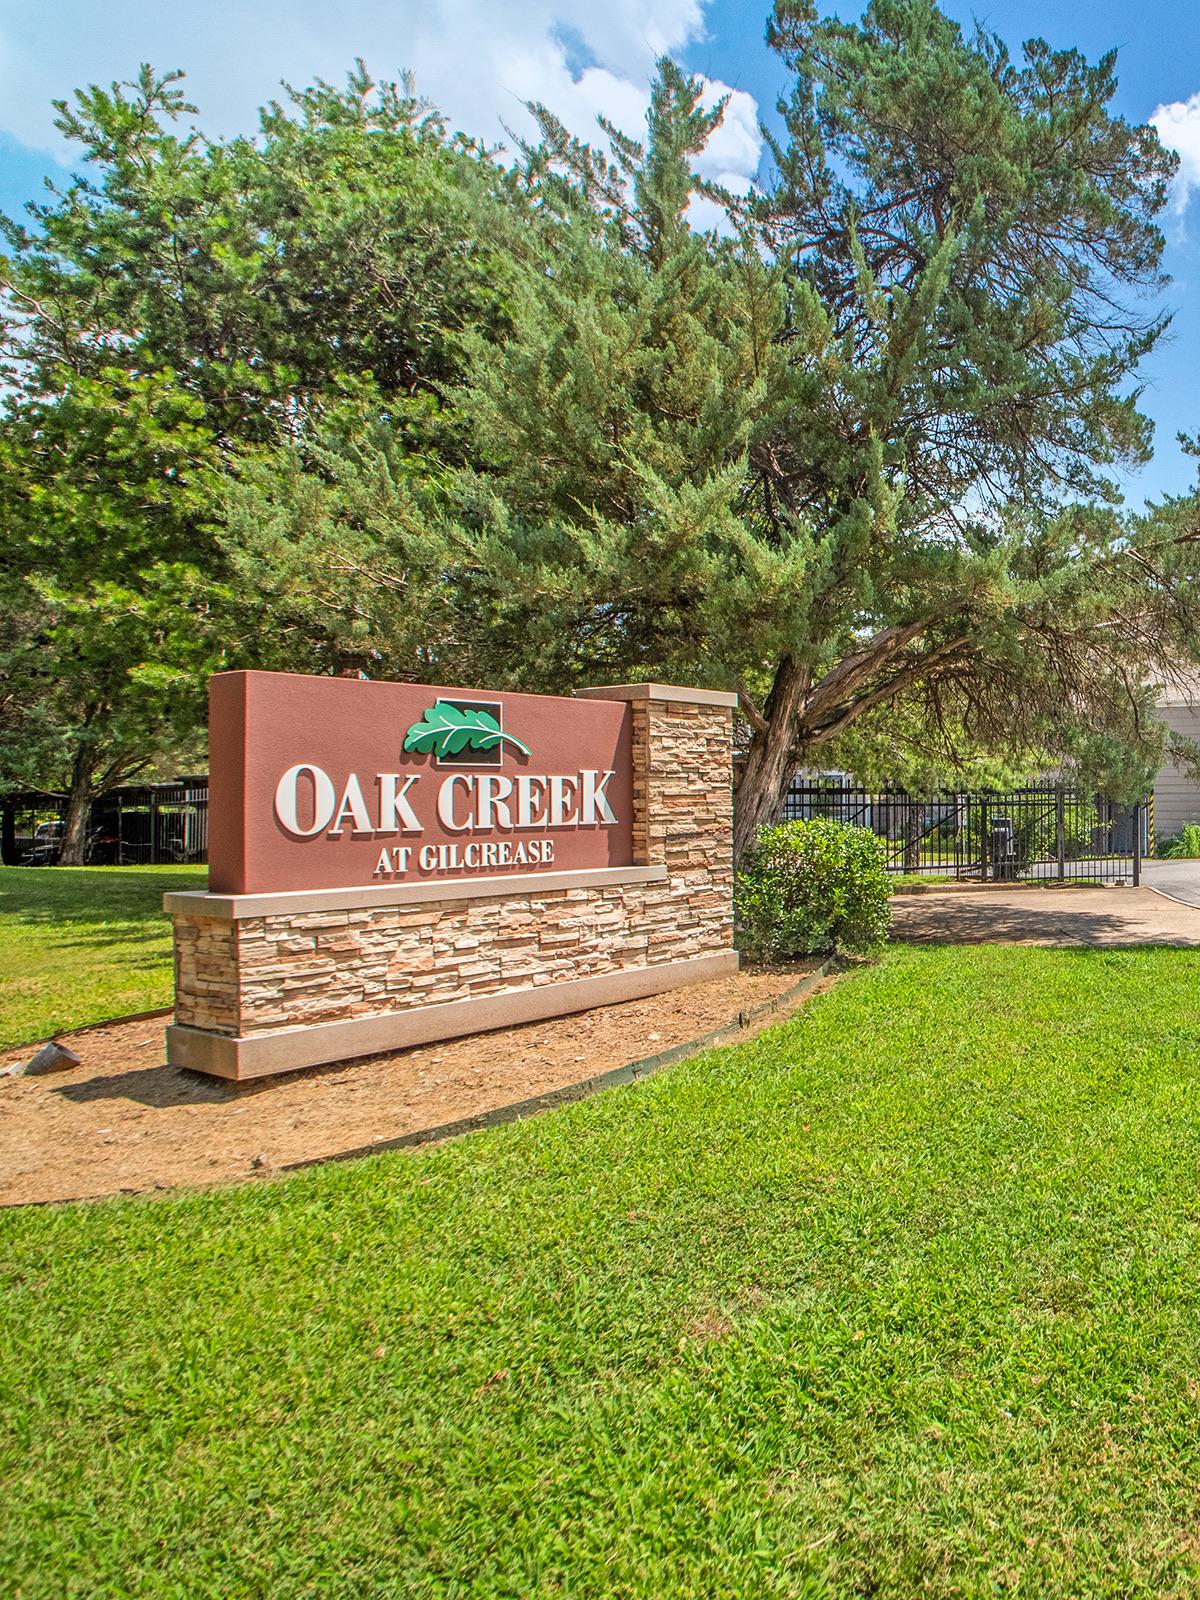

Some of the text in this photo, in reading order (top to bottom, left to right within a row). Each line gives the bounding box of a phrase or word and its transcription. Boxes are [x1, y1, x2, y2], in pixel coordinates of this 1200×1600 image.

[274, 763, 618, 836] OAK CREEK
[374, 840, 555, 875] AT GILCREASE
